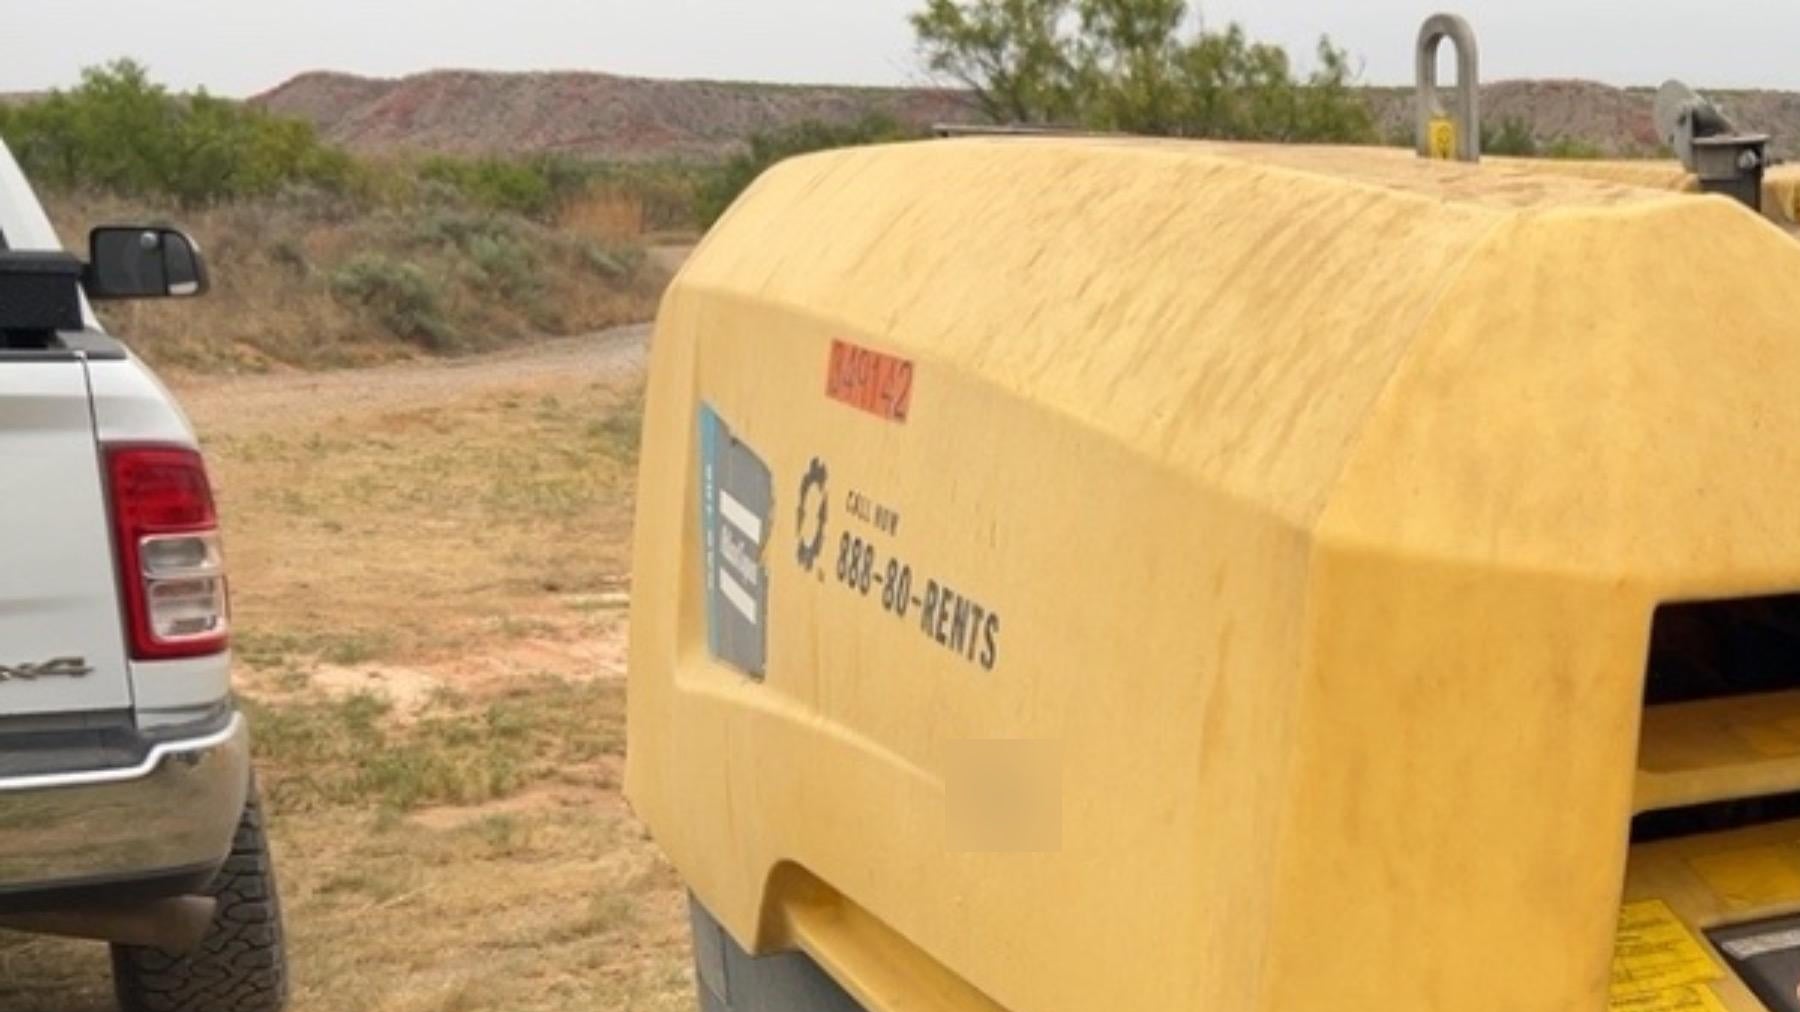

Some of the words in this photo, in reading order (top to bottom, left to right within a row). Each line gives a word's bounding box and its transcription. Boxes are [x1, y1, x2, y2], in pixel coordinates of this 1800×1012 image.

[845, 490, 870, 522] CALL
[873, 504, 899, 536] NOW
[837, 531, 1000, 670] 888-80-RENTS
